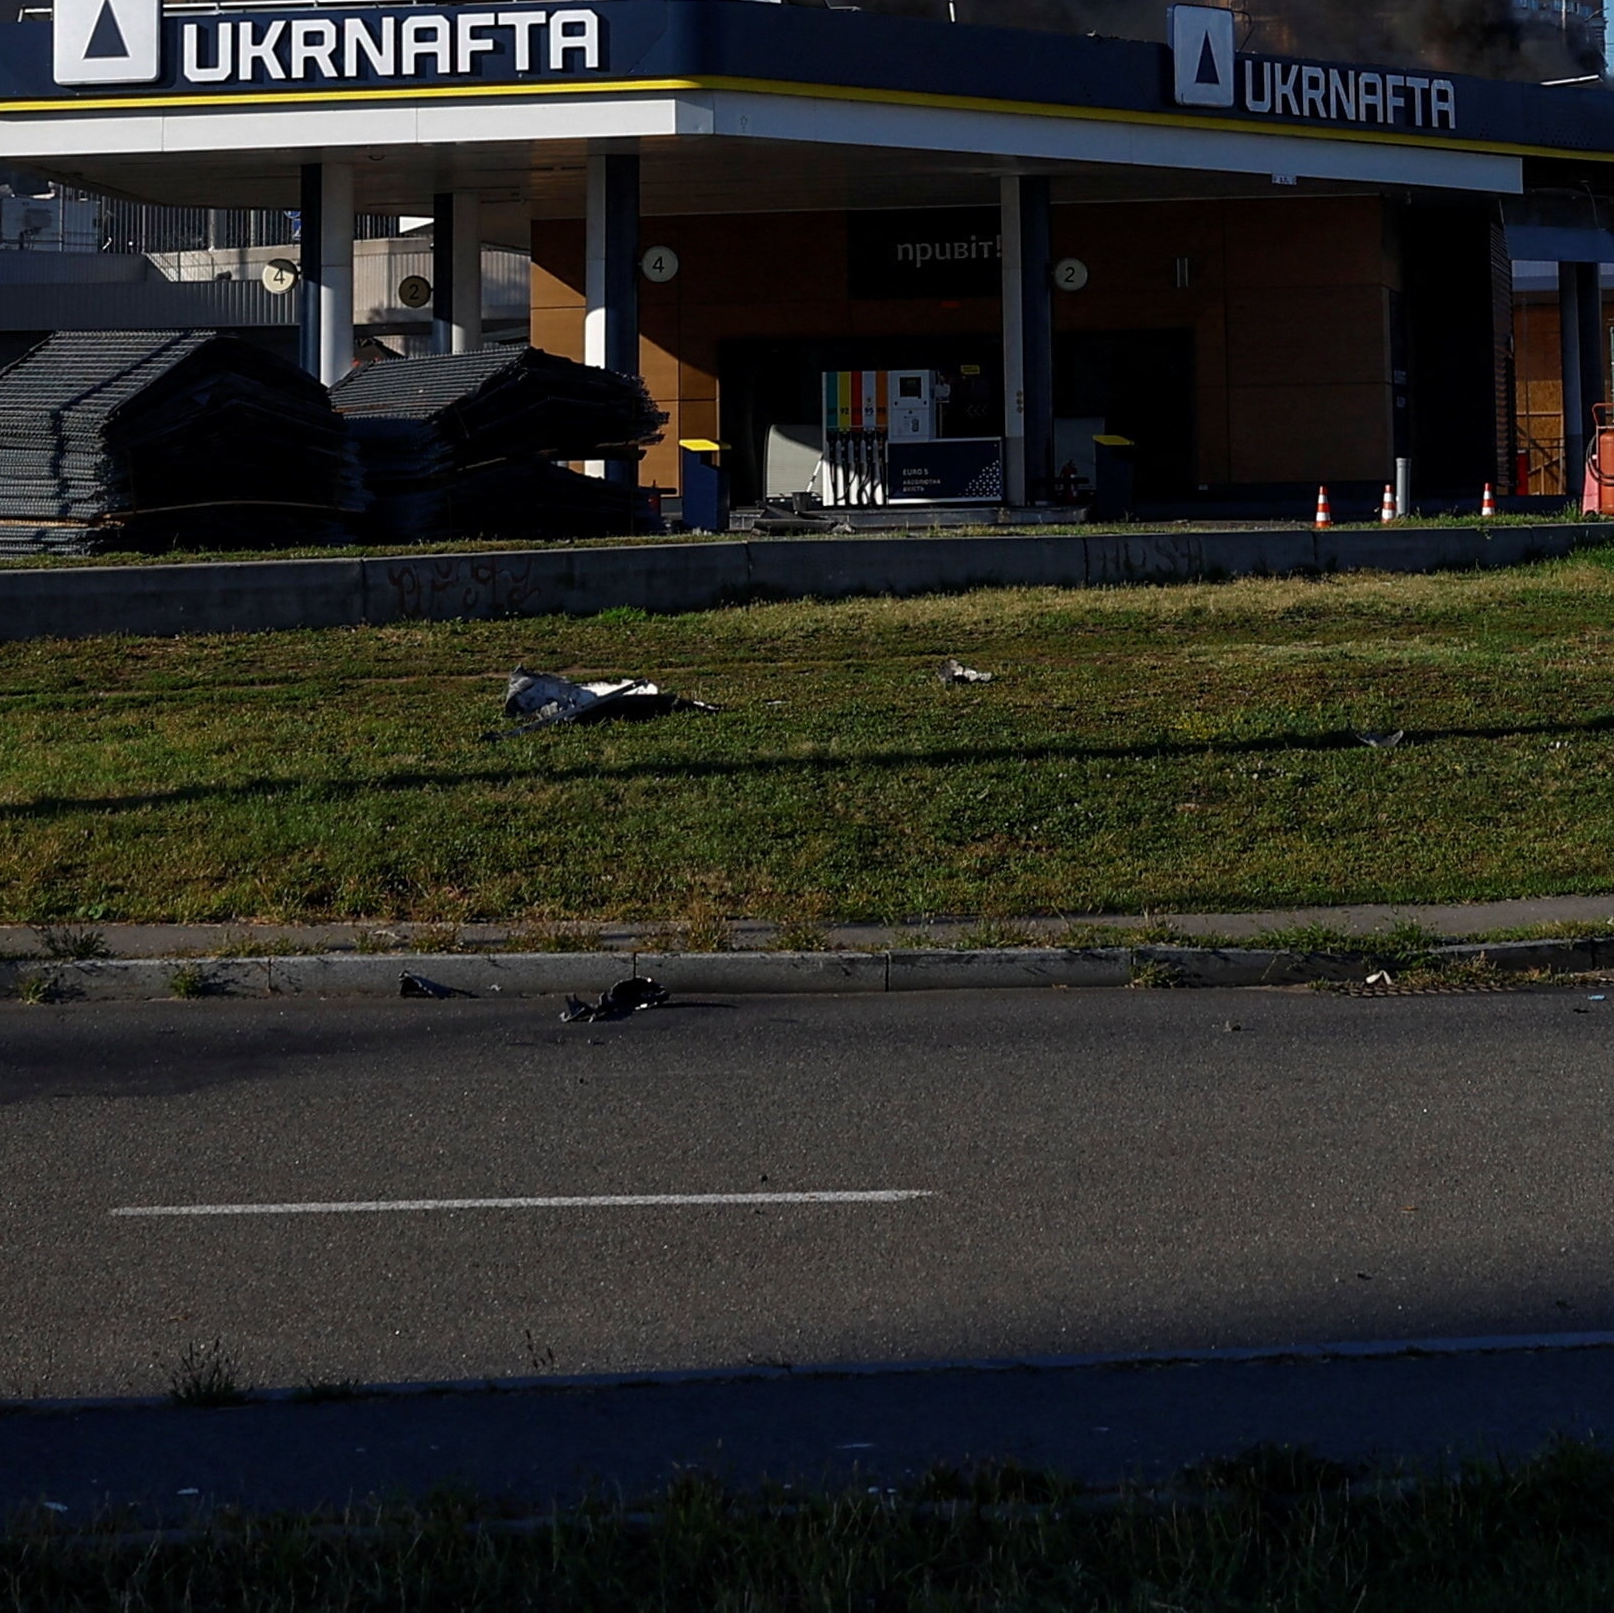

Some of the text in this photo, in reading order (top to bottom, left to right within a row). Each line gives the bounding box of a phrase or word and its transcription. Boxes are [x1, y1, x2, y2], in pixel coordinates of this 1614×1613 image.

[182, 8, 600, 83] UKRNAFTA
[1244, 58, 1457, 130] UKRNAFTA
[652, 256, 665, 274] 4
[273, 267, 286, 286] 4
[1064, 266, 1076, 283] 2
[409, 283, 420, 300] 2
